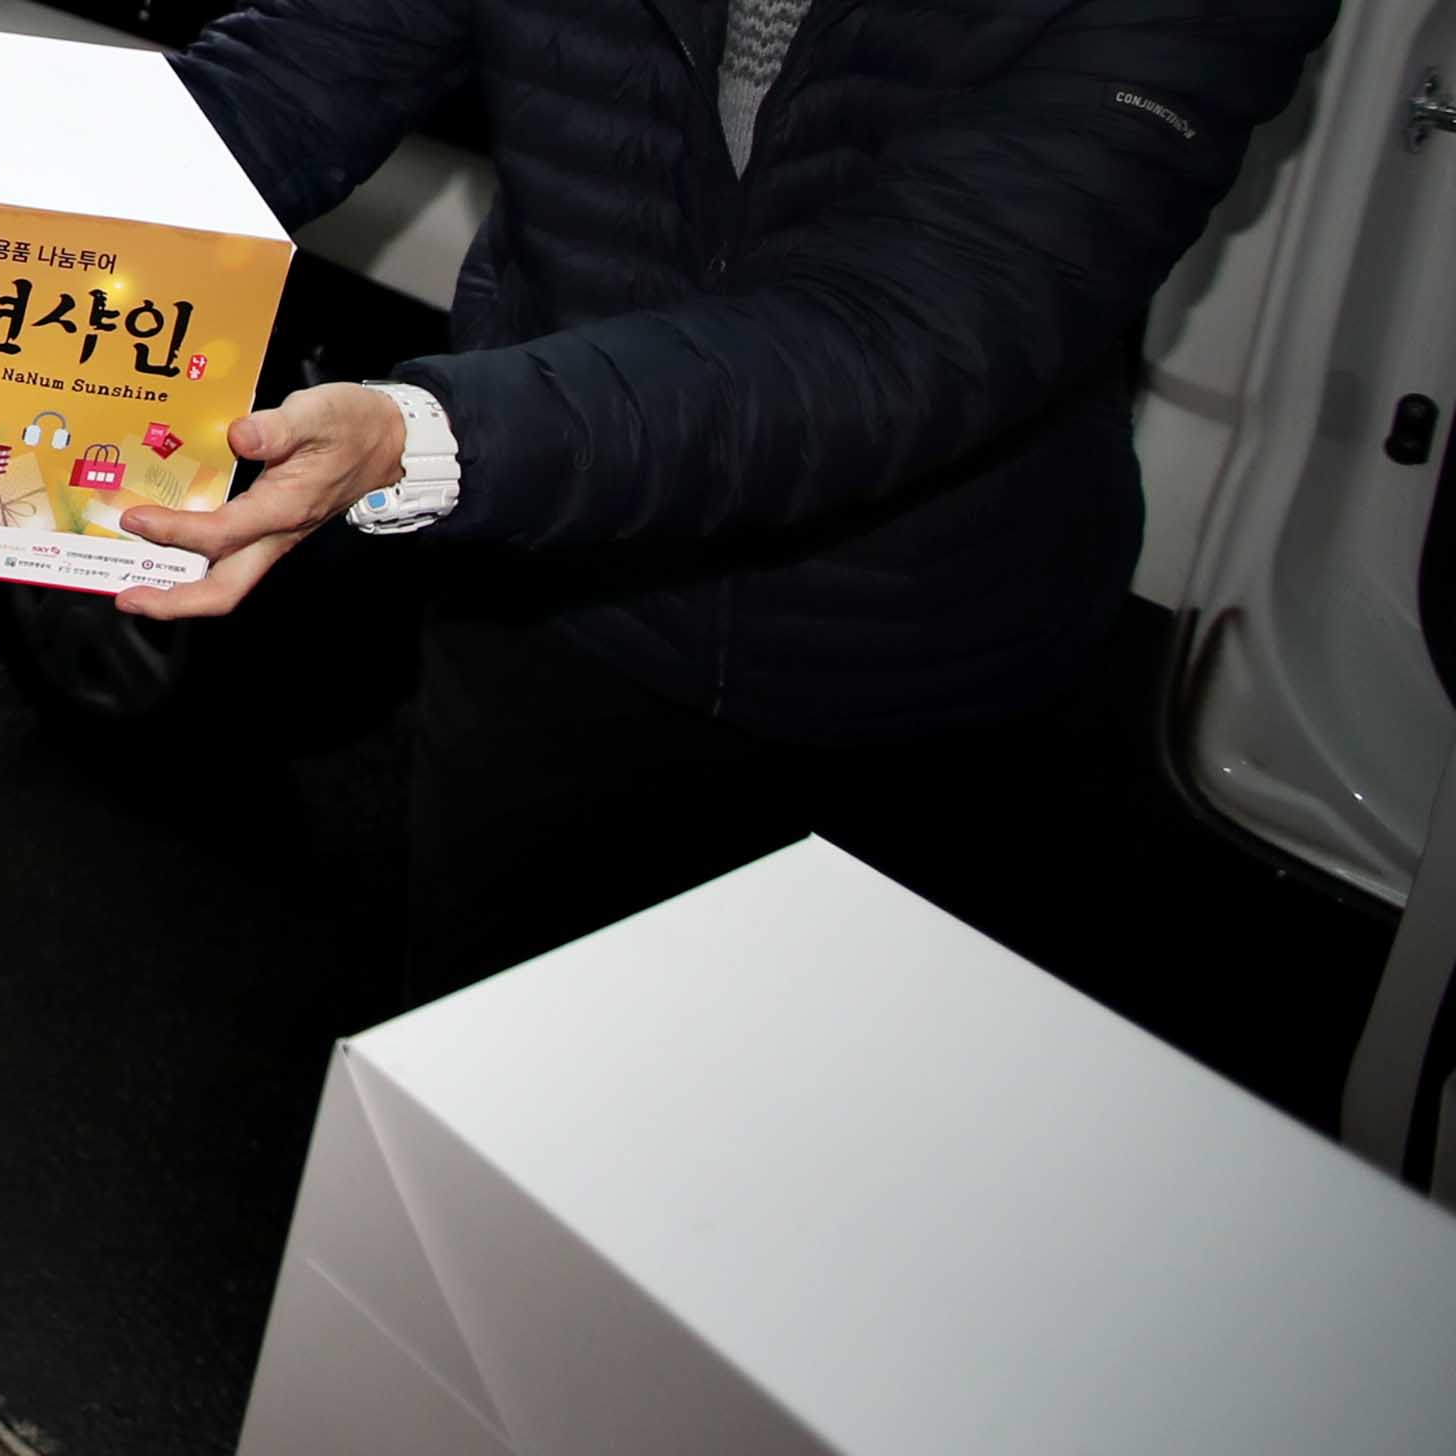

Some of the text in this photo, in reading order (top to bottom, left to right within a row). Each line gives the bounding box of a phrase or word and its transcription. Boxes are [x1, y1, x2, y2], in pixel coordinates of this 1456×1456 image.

[37, 245, 118, 275] 나눔투어
[1, 367, 169, 402] NaNum Sunshine
